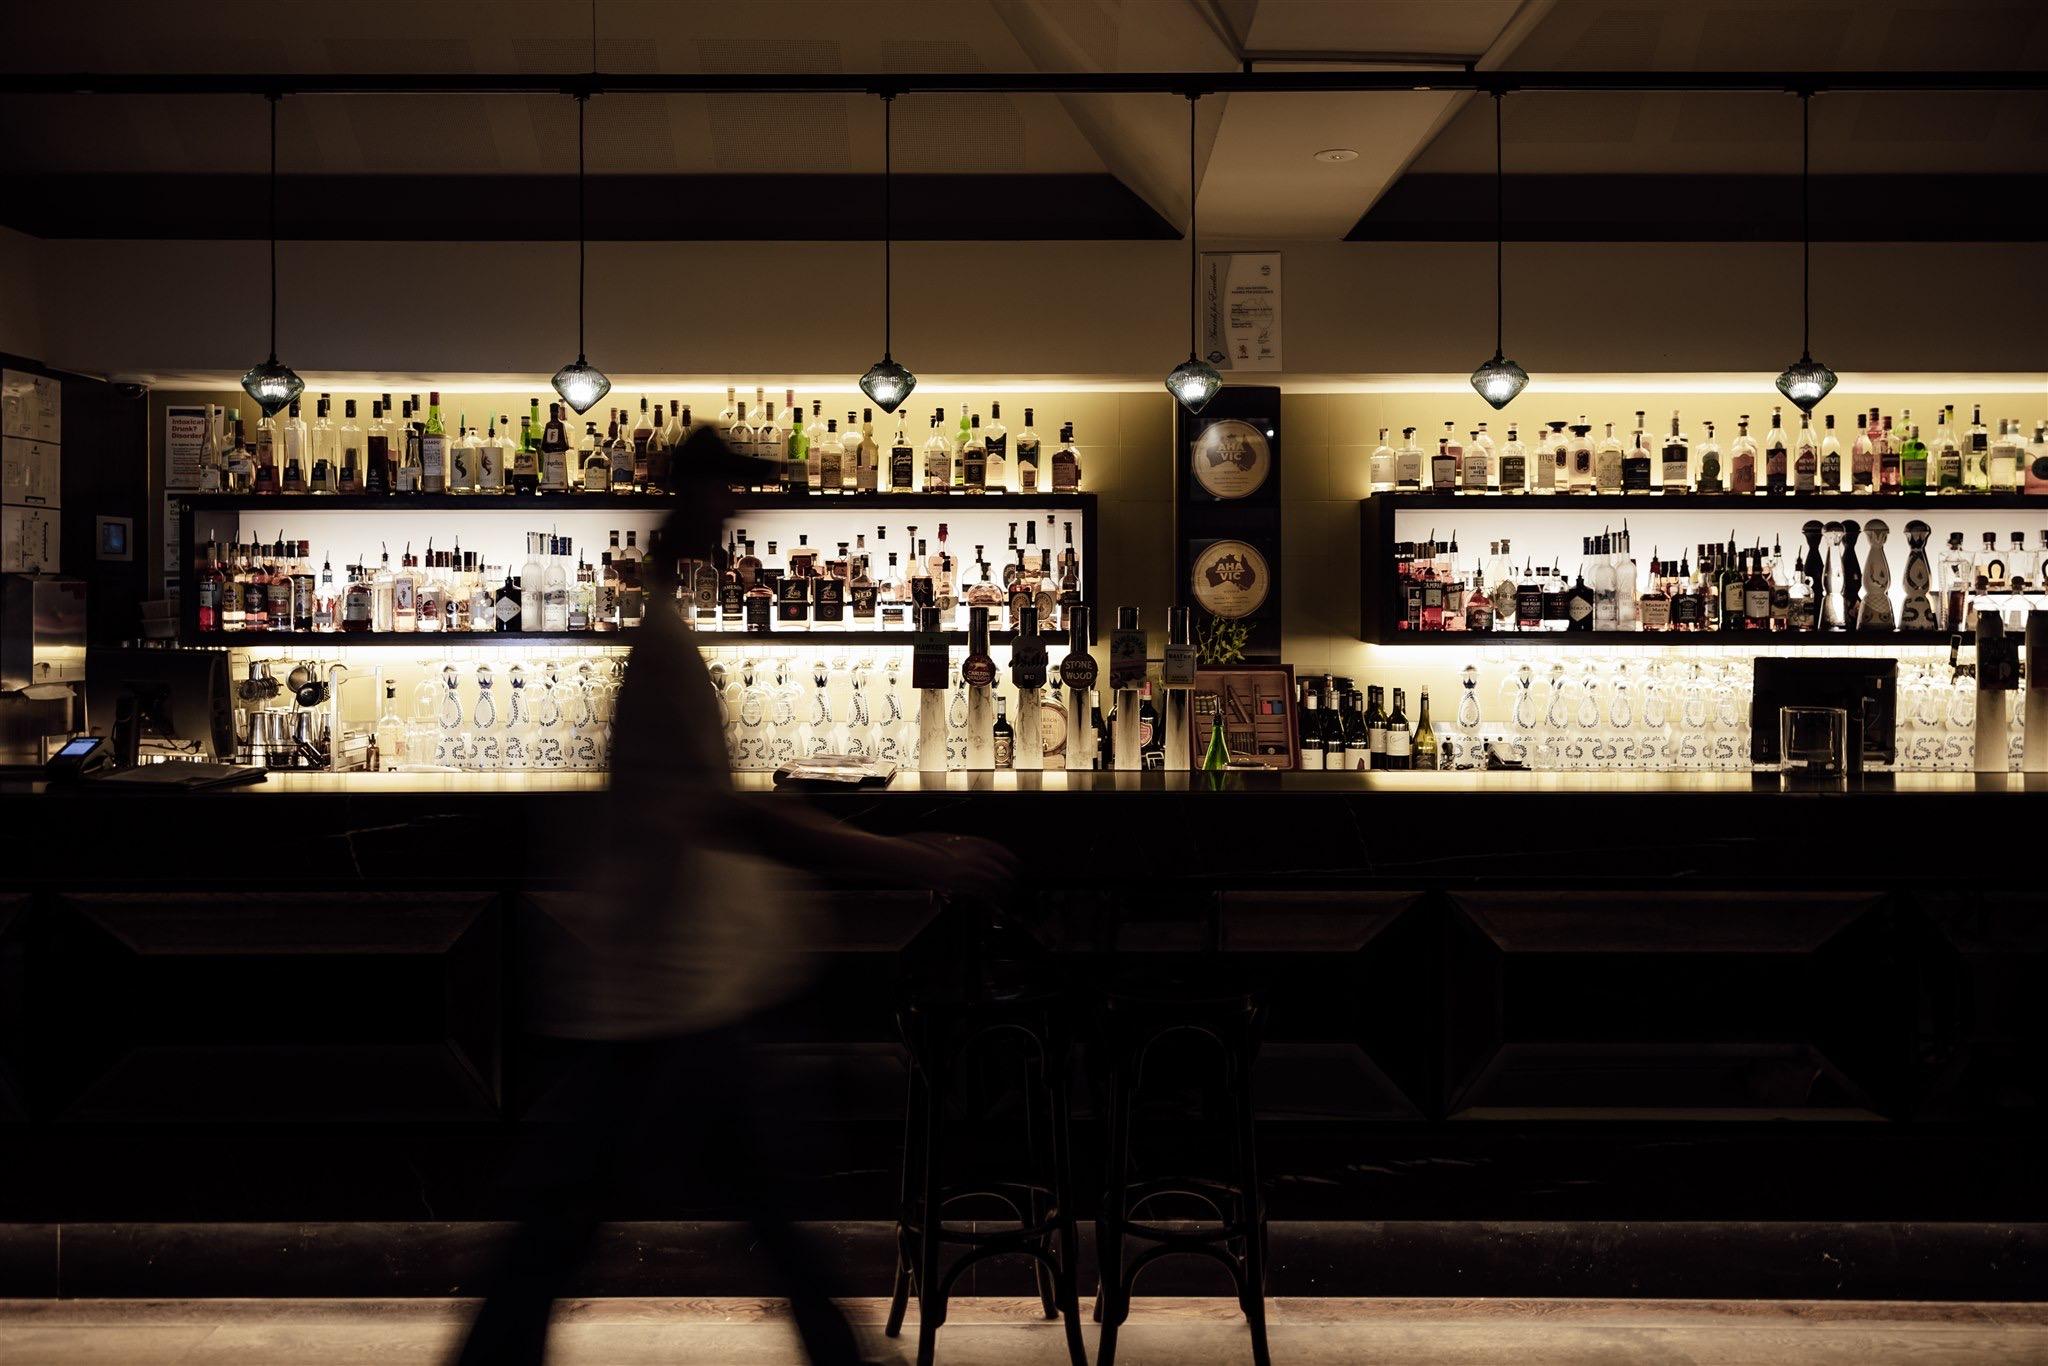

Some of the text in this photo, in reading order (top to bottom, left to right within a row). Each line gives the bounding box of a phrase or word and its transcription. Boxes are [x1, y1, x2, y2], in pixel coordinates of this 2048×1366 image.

[1218, 442, 1244, 450] AHA
[1220, 452, 1242, 461] VIC
[1216, 562, 1244, 571] AHA
[1219, 572, 1241, 581] VIC
[854, 591, 872, 600] NED
[1065, 660, 1093, 669] STONE
[1066, 671, 1093, 680] WOOD
